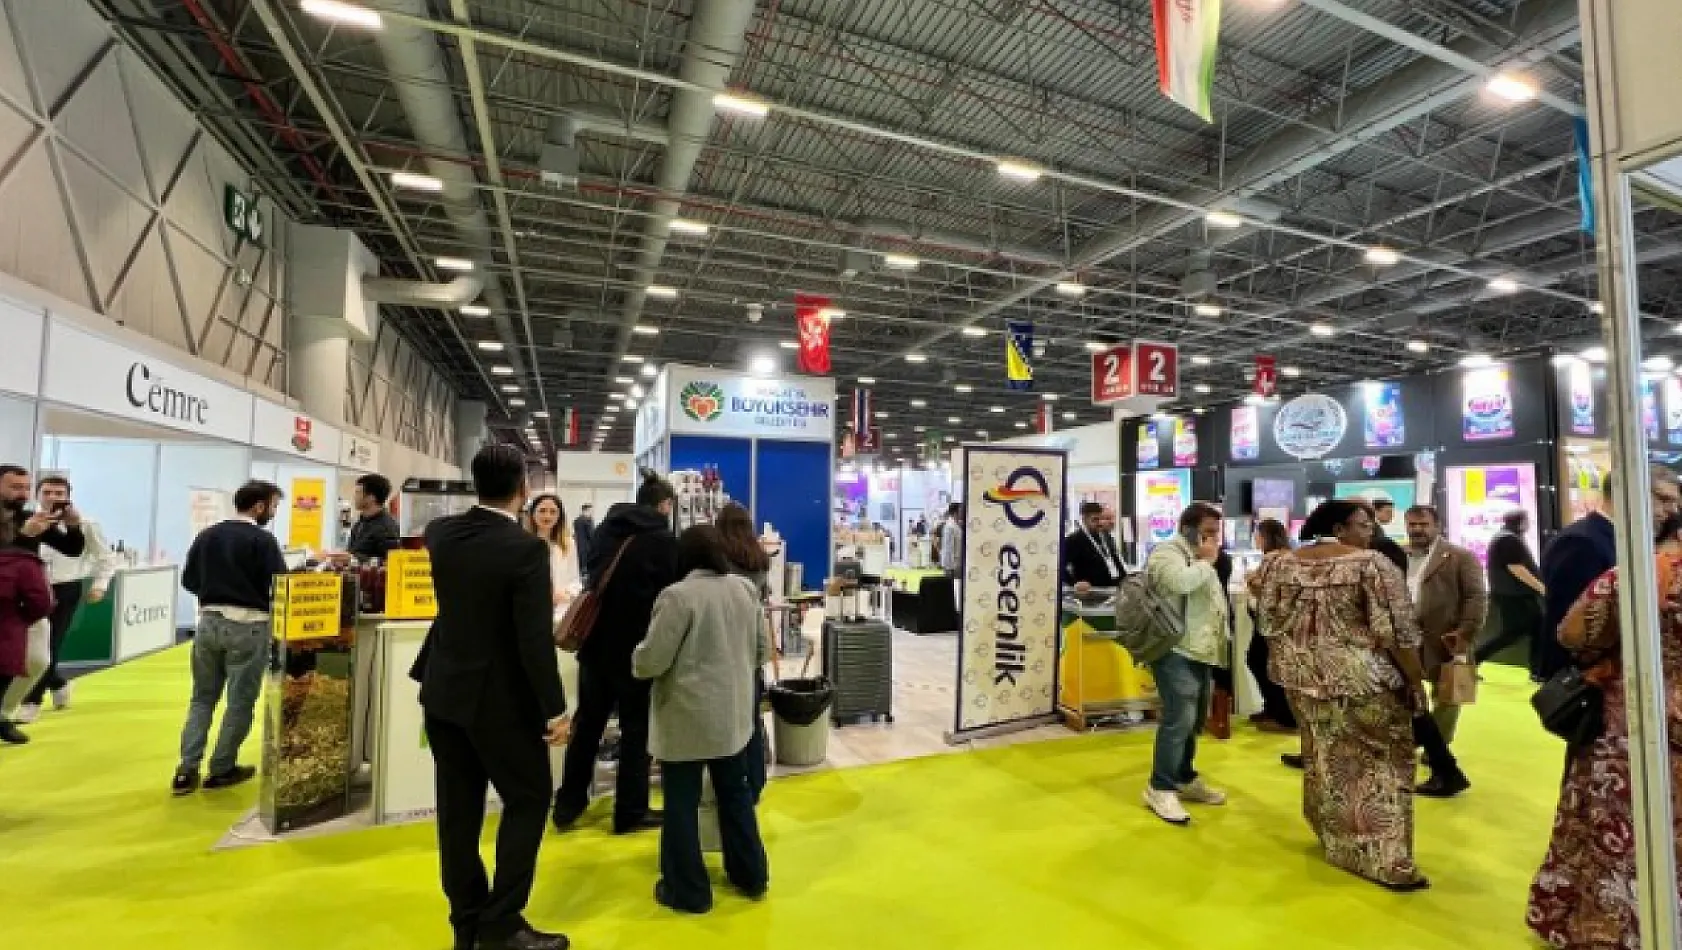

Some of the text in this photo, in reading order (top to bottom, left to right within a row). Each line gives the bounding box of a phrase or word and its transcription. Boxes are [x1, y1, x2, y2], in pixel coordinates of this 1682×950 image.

[1104, 354, 1120, 385] 2
[1150, 351, 1166, 382] 2
[126, 362, 209, 425] Cemre
[995, 544, 1026, 687] esenlik
